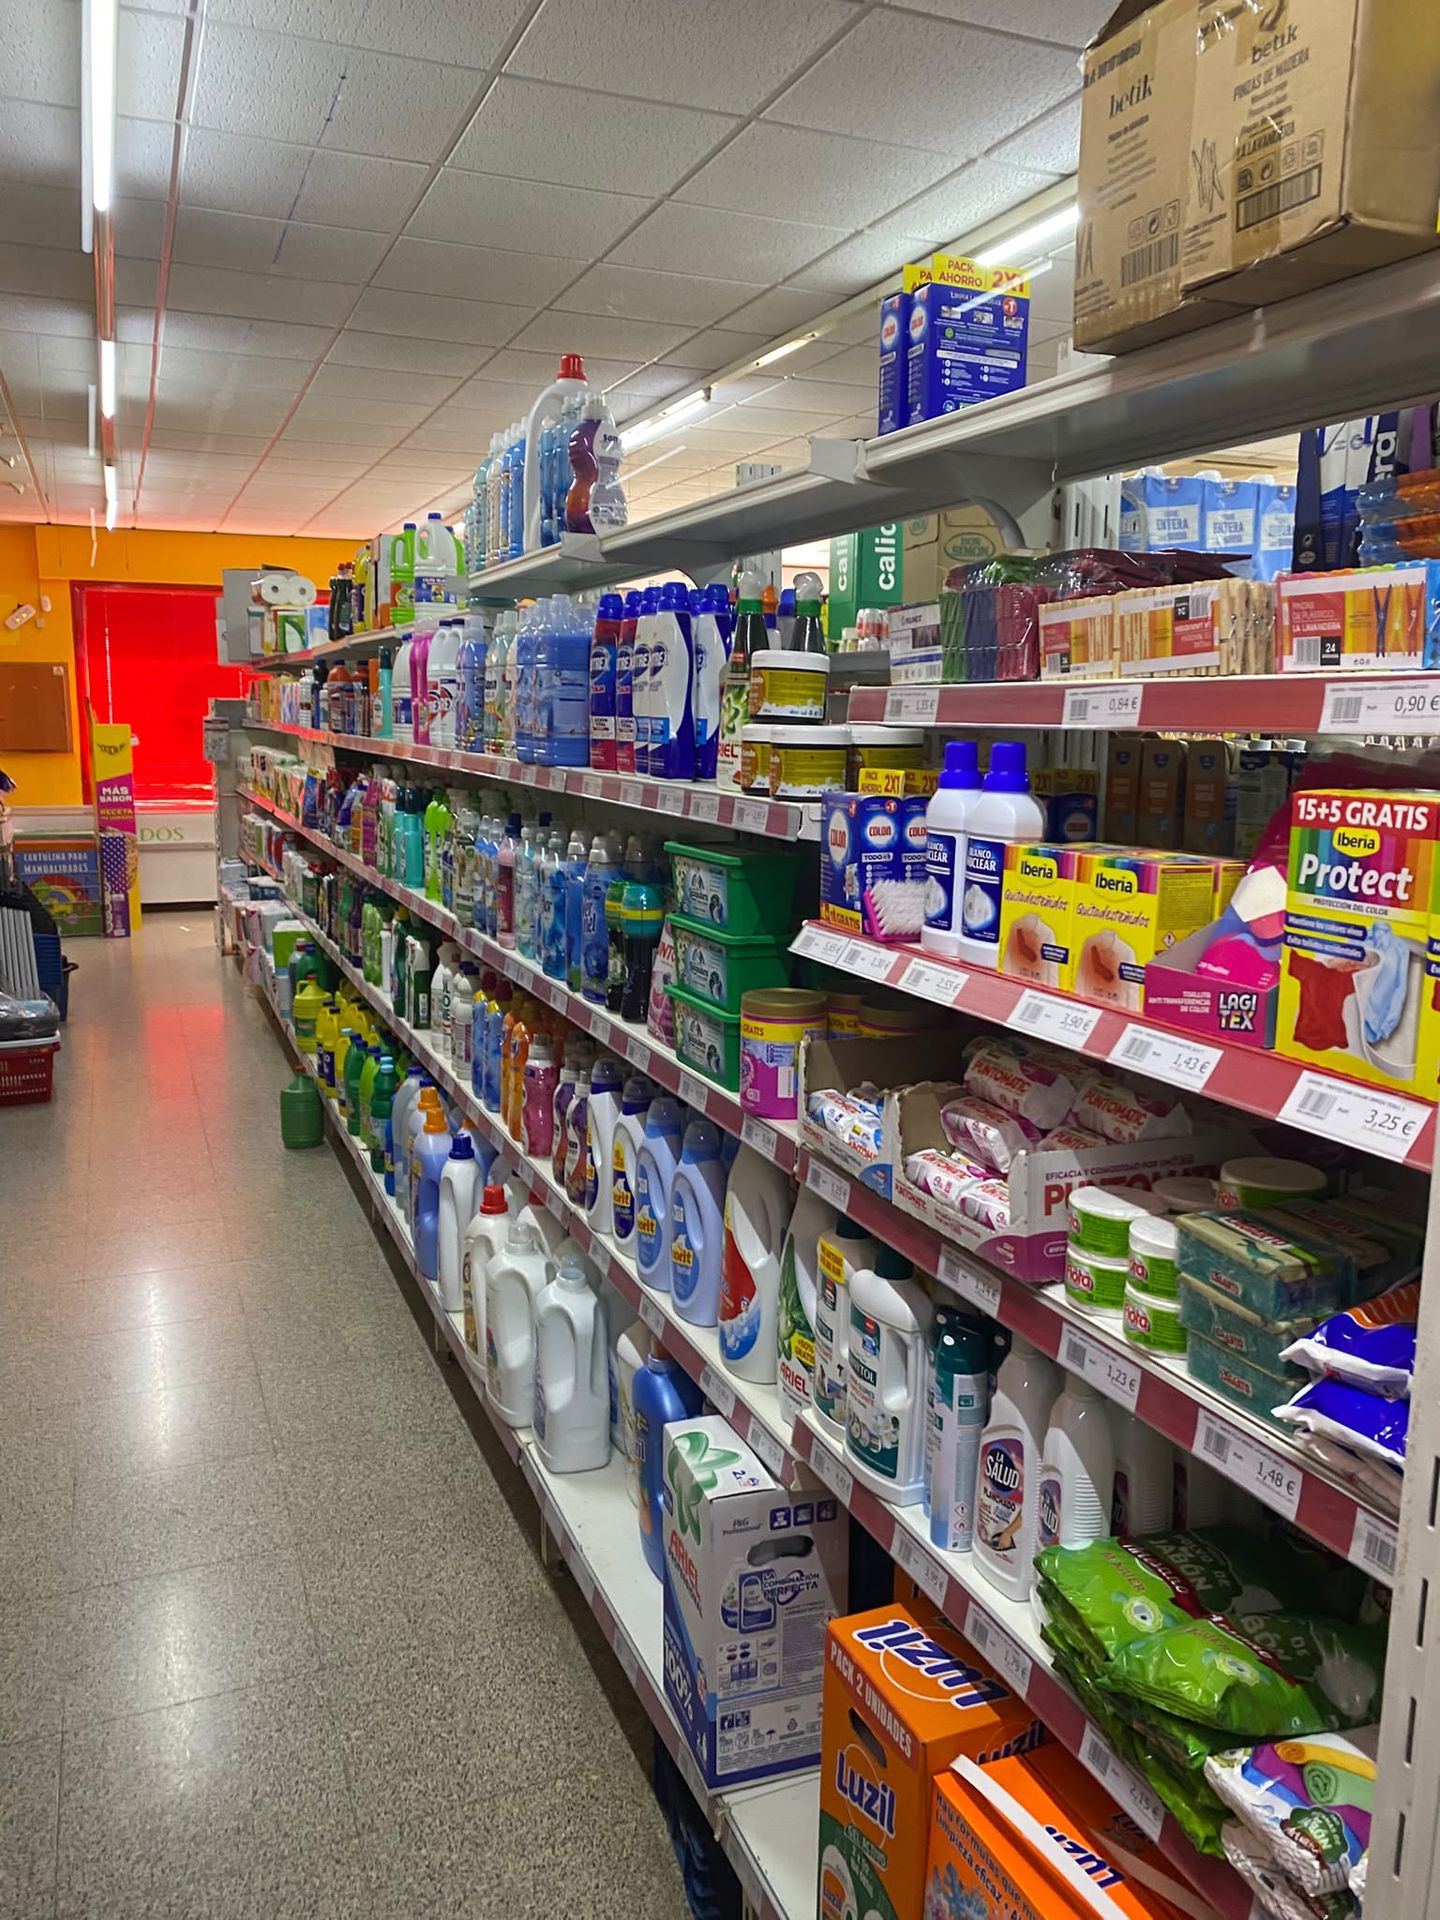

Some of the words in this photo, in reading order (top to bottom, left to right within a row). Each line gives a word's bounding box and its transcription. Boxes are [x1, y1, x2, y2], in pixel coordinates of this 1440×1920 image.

[948, 260, 975, 273] PACK
[939, 271, 982, 287] AHORRO
[1325, 643, 1336, 653] 24
[1394, 695, 1425, 713] 0,90
[1298, 798, 1342, 823] 15+5
[1345, 801, 1430, 831] GRATIS
[140, 828, 184, 841] DOS
[830, 829, 847, 849] COLON
[869, 826, 892, 837] COLON
[1337, 831, 1376, 850] Iberia
[1020, 861, 1053, 879] Iberia
[1298, 853, 1414, 901] Protect
[1095, 873, 1133, 893] Iberia
[1365, 905, 1388, 916] COLOR
[1219, 993, 1257, 1011] LAGI
[1219, 1010, 1254, 1030] TEX
[1173, 1053, 1200, 1071] 1,43
[1199, 1061, 1210, 1074] €
[971, 1060, 1032, 1094] PUNTOMATIC
[1082, 1088, 1148, 1127] PUNTOMATIC
[1364, 1109, 1402, 1131] 3,25
[1402, 1120, 1416, 1136] €
[1050, 1129, 1093, 1150] PUNTO
[1045, 1169, 1082, 1181] EFICACIA
[976, 1183, 1009, 1205] PUNTO
[780, 1361, 810, 1397] ARIEL
[1106, 1365, 1127, 1387] 1,23
[1129, 1378, 1137, 1393] €
[996, 1451, 1004, 1464] LA
[985, 1455, 1020, 1489] SALUD
[1257, 1461, 1284, 1488] 1,48
[1286, 1480, 1296, 1496] €
[763, 1581, 819, 1598] PERFECTA
[830, 1641, 854, 1686] PACK
[856, 1674, 863, 1696] 2
[865, 1683, 912, 1759] UNIDADES
[835, 1750, 897, 1839] Luzil
